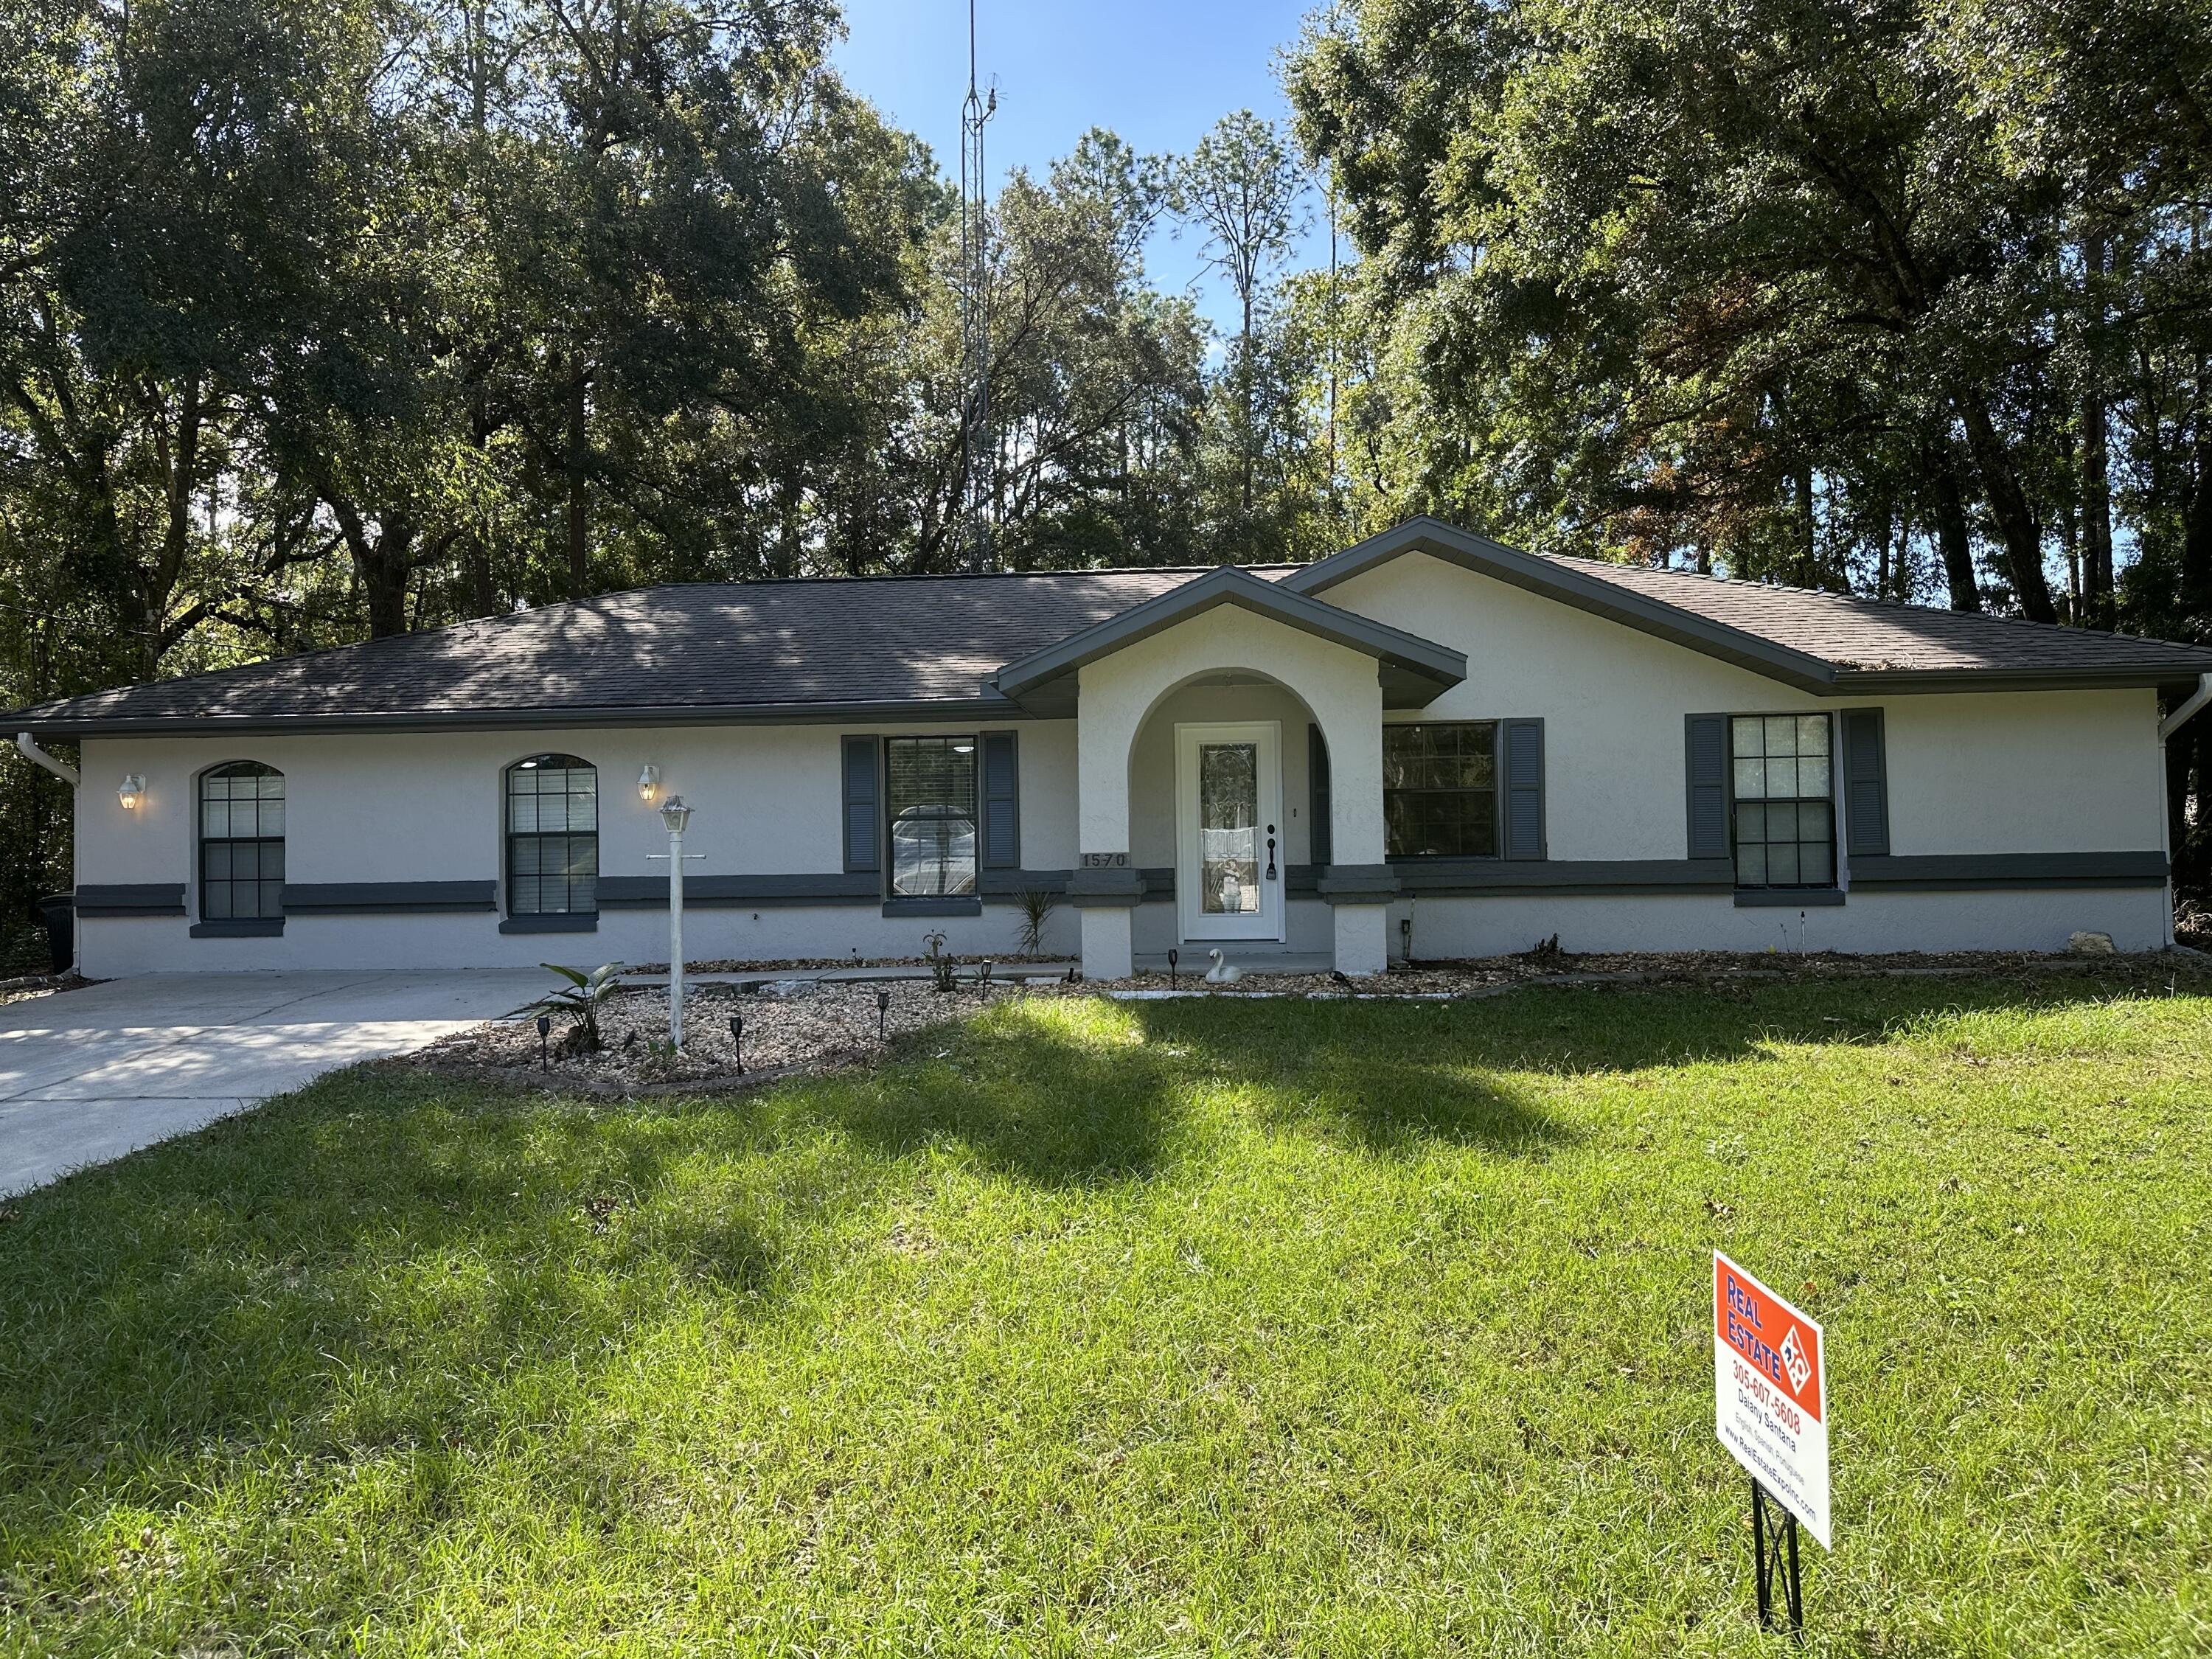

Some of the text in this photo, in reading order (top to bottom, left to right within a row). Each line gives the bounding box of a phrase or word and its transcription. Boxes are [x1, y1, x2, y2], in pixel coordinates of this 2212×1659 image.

[1084, 854, 1125, 867] 1570
[1727, 1273, 1763, 1330] REAL
[1727, 1308, 1781, 1382] ESTATE
[1733, 1360, 1801, 1436] 305-607-5608
[1738, 1388, 1796, 1453] Daiany Santana
[1725, 1424, 1816, 1521] www.RealEstateExpoInc.com
